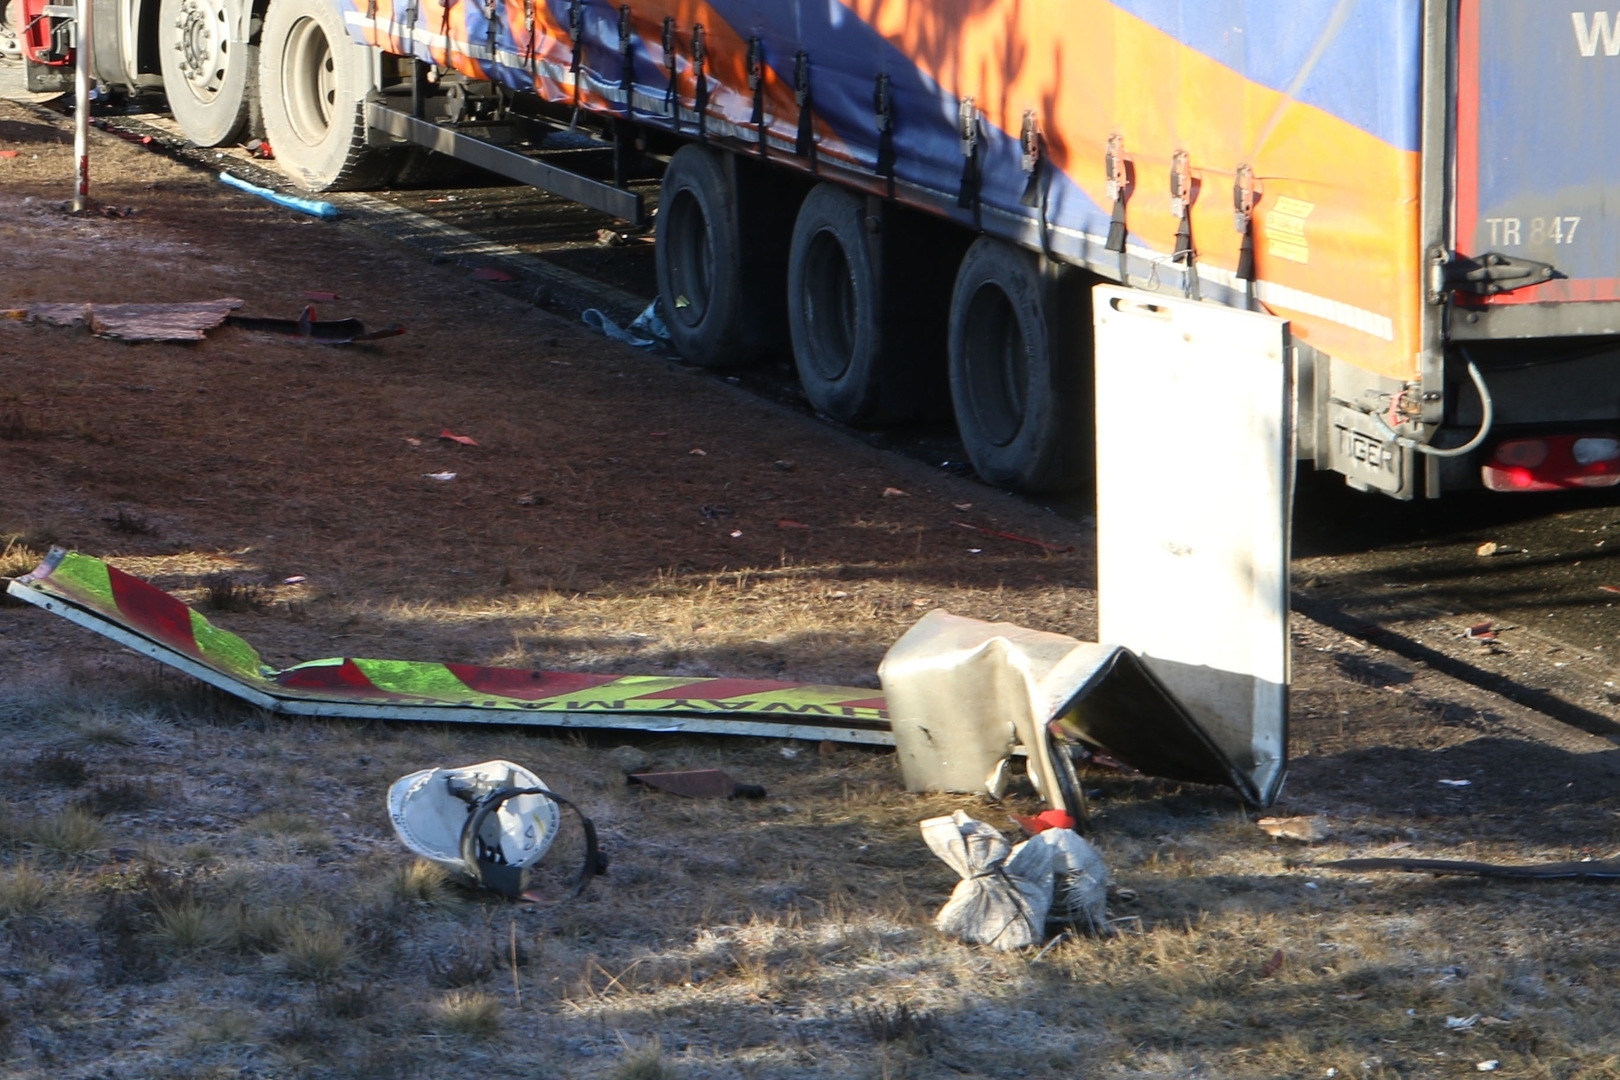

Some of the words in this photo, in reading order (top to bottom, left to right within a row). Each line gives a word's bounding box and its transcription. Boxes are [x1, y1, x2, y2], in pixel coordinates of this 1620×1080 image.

[1485, 217, 1521, 246] TR
[1529, 216, 1581, 245] 847
[1333, 423, 1394, 475] TIGER
